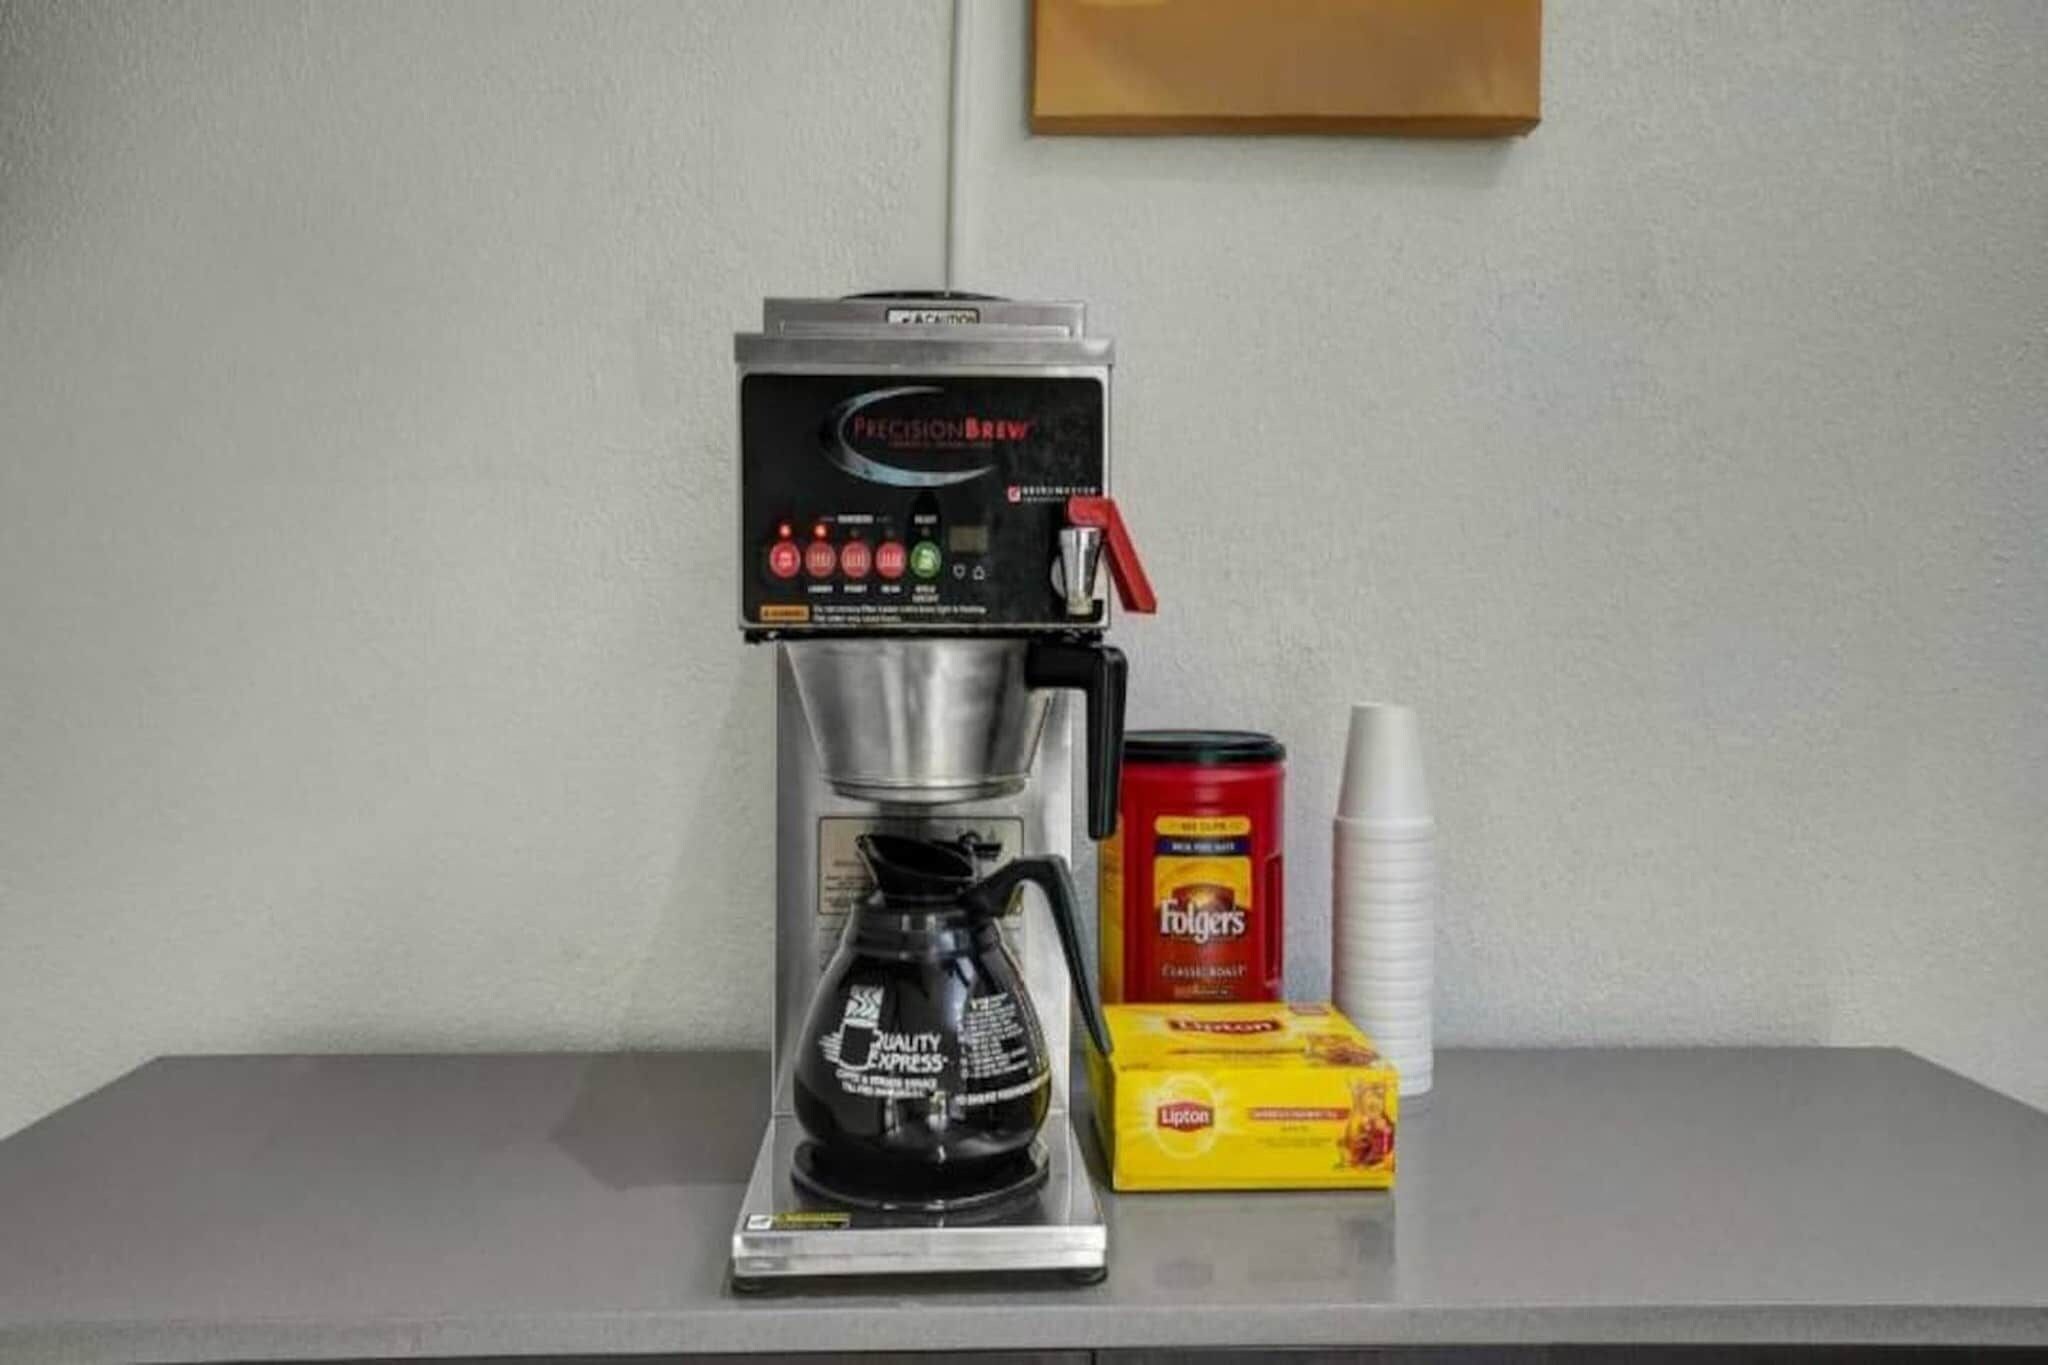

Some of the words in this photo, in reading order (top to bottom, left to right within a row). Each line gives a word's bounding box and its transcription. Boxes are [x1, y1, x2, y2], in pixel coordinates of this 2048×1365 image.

[1160, 897, 1246, 945] Folgers
[1175, 1018, 1275, 1033] Lipton
[868, 1050, 944, 1074] EXPRESS
[1160, 1108, 1210, 1127] Lipton
